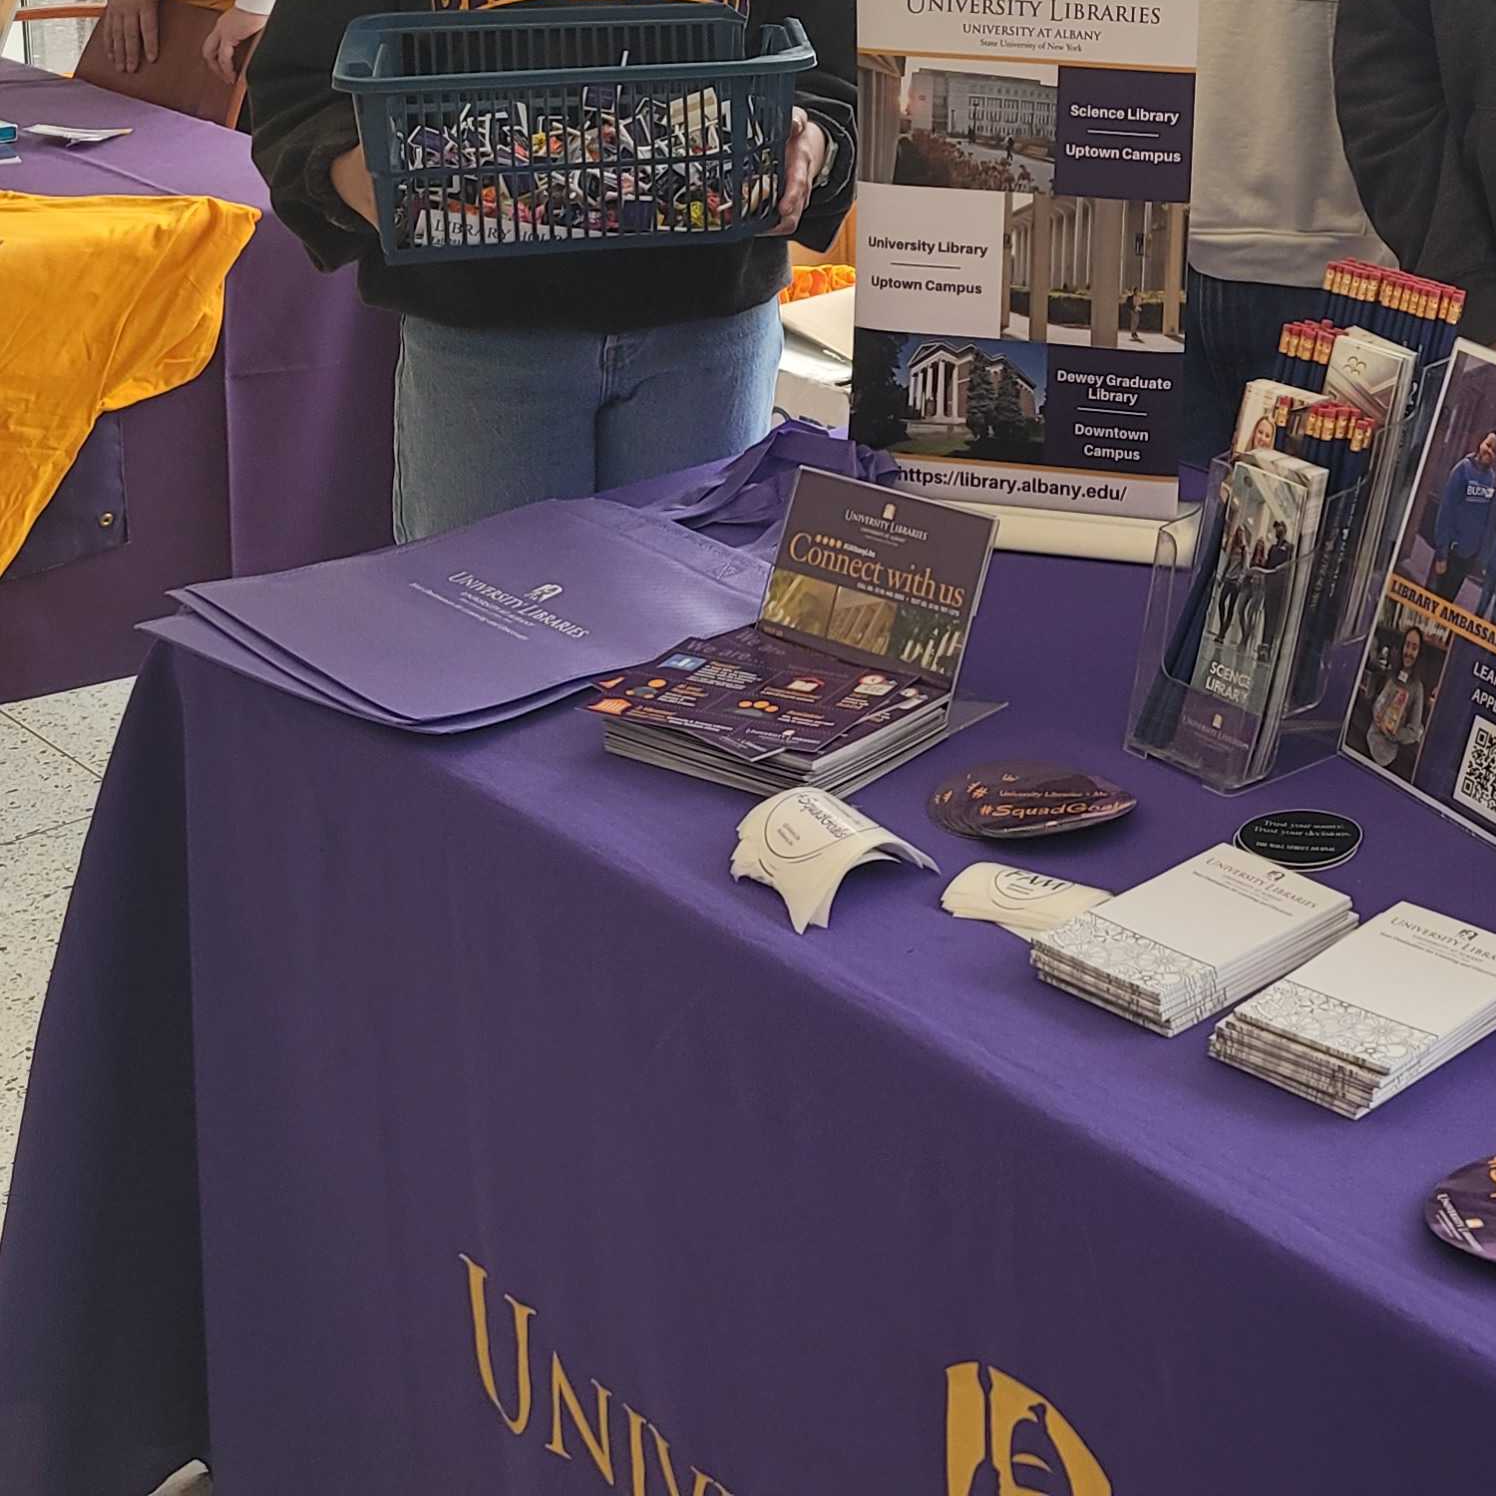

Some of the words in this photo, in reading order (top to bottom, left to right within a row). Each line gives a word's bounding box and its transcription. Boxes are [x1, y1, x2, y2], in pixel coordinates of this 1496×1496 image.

[962, 23, 1035, 38] UNIVERSITY
[1037, 28, 1052, 38] AT
[1054, 28, 1102, 41] ALBANY
[1070, 104, 1125, 120] Science
[1127, 107, 1180, 126] Library
[1065, 143, 1120, 159] Uptown
[1122, 147, 1181, 165] Campus
[433, 217, 514, 241] LBRARY
[868, 235, 936, 256] University
[937, 241, 989, 258] Library
[871, 275, 923, 292] Uptown
[925, 279, 983, 295] Campus
[1056, 369, 1105, 389] Dewey
[1106, 374, 1172, 391] Graduate
[1087, 388, 1138, 406] Library
[1074, 423, 1149, 443] Downtown
[1083, 444, 1141, 462] Campus
[898, 466, 1128, 502] https://library.albany.edu/
[789, 531, 884, 585] Connect
[887, 562, 936, 602] with
[939, 582, 966, 609] us
[448, 570, 523, 609] UNIVERSITY
[1392, 579, 1441, 614] LIBRARY
[458, 1253, 736, 1496] UNIV
